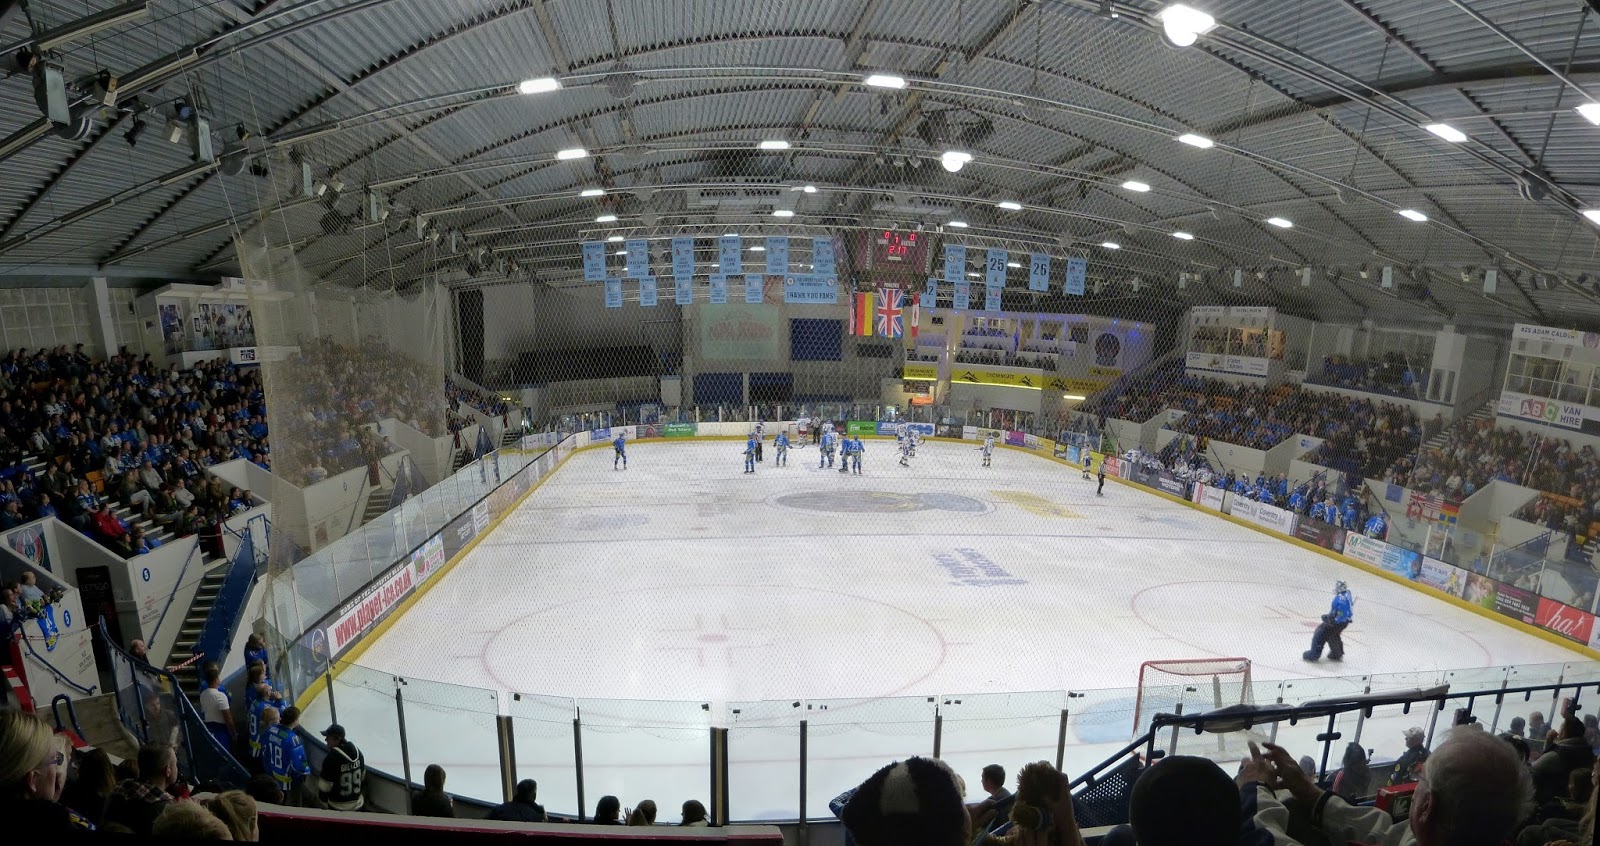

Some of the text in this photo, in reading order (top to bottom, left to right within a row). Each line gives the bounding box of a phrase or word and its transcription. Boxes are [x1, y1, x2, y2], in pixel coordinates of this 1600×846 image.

[990, 257, 1004, 271] 25
[1033, 262, 1047, 276] 26
[787, 291, 806, 299] THANK
[1533, 328, 1549, 336] ADAM
[1563, 405, 1581, 416] VAN
[1560, 415, 1581, 426] HIRE
[1259, 507, 1279, 520] Coventry
[143, 570, 150, 580] 5
[334, 567, 412, 649] www.planet-ice.co.uk
[64, 612, 70, 625] 5
[268, 743, 282, 769] 18
[339, 769, 362, 796] 99
